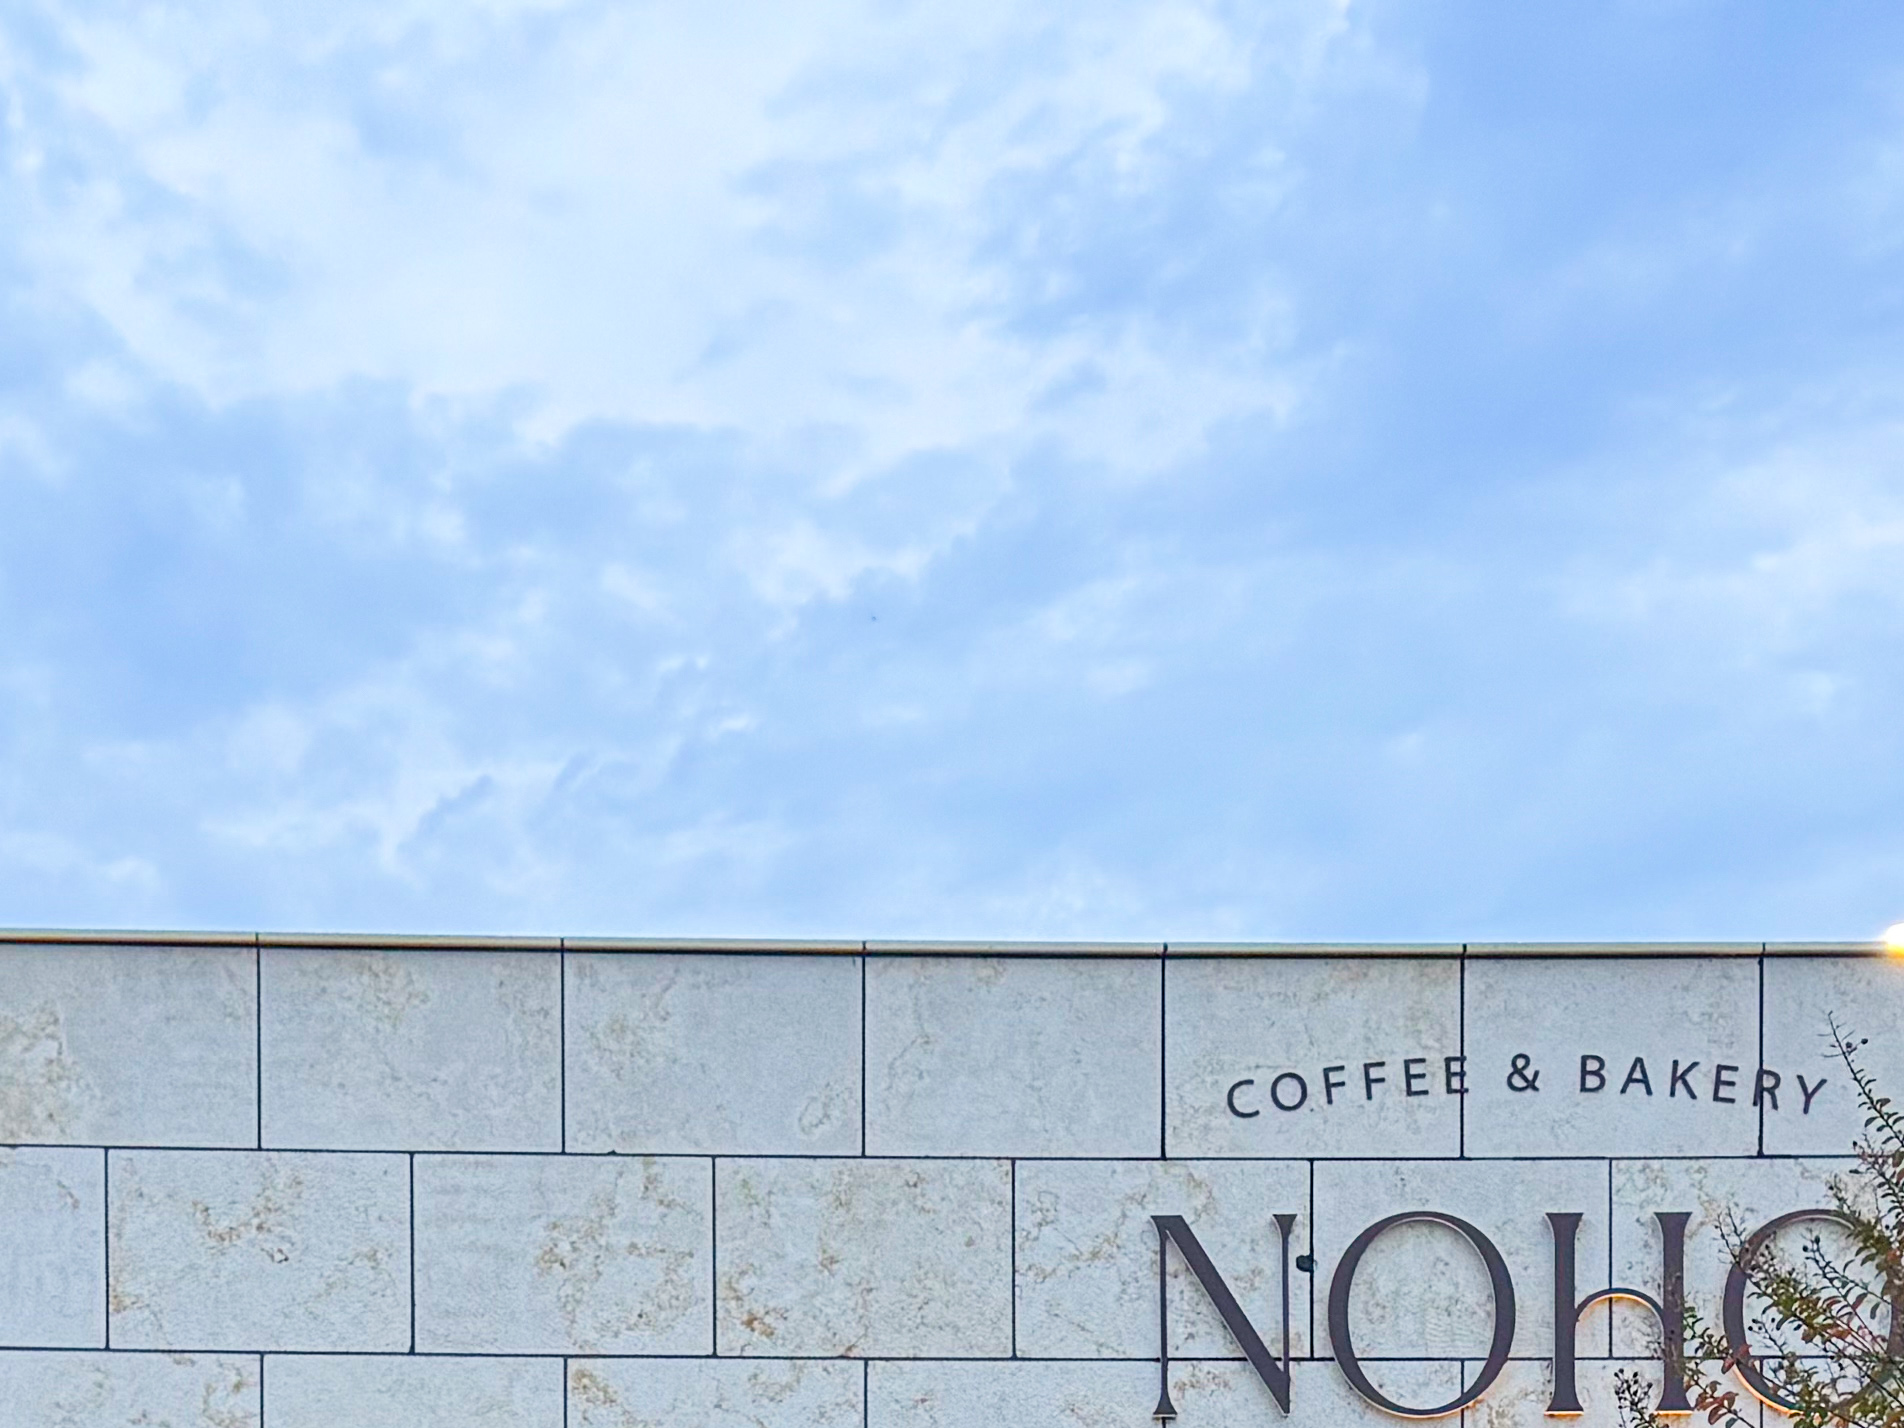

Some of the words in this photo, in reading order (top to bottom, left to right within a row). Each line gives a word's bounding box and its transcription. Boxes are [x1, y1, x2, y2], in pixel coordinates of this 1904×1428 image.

[1226, 1055, 1469, 1119] COFFEE
[1506, 1053, 1541, 1093] &
[1578, 1053, 1828, 1115] BAKERY
